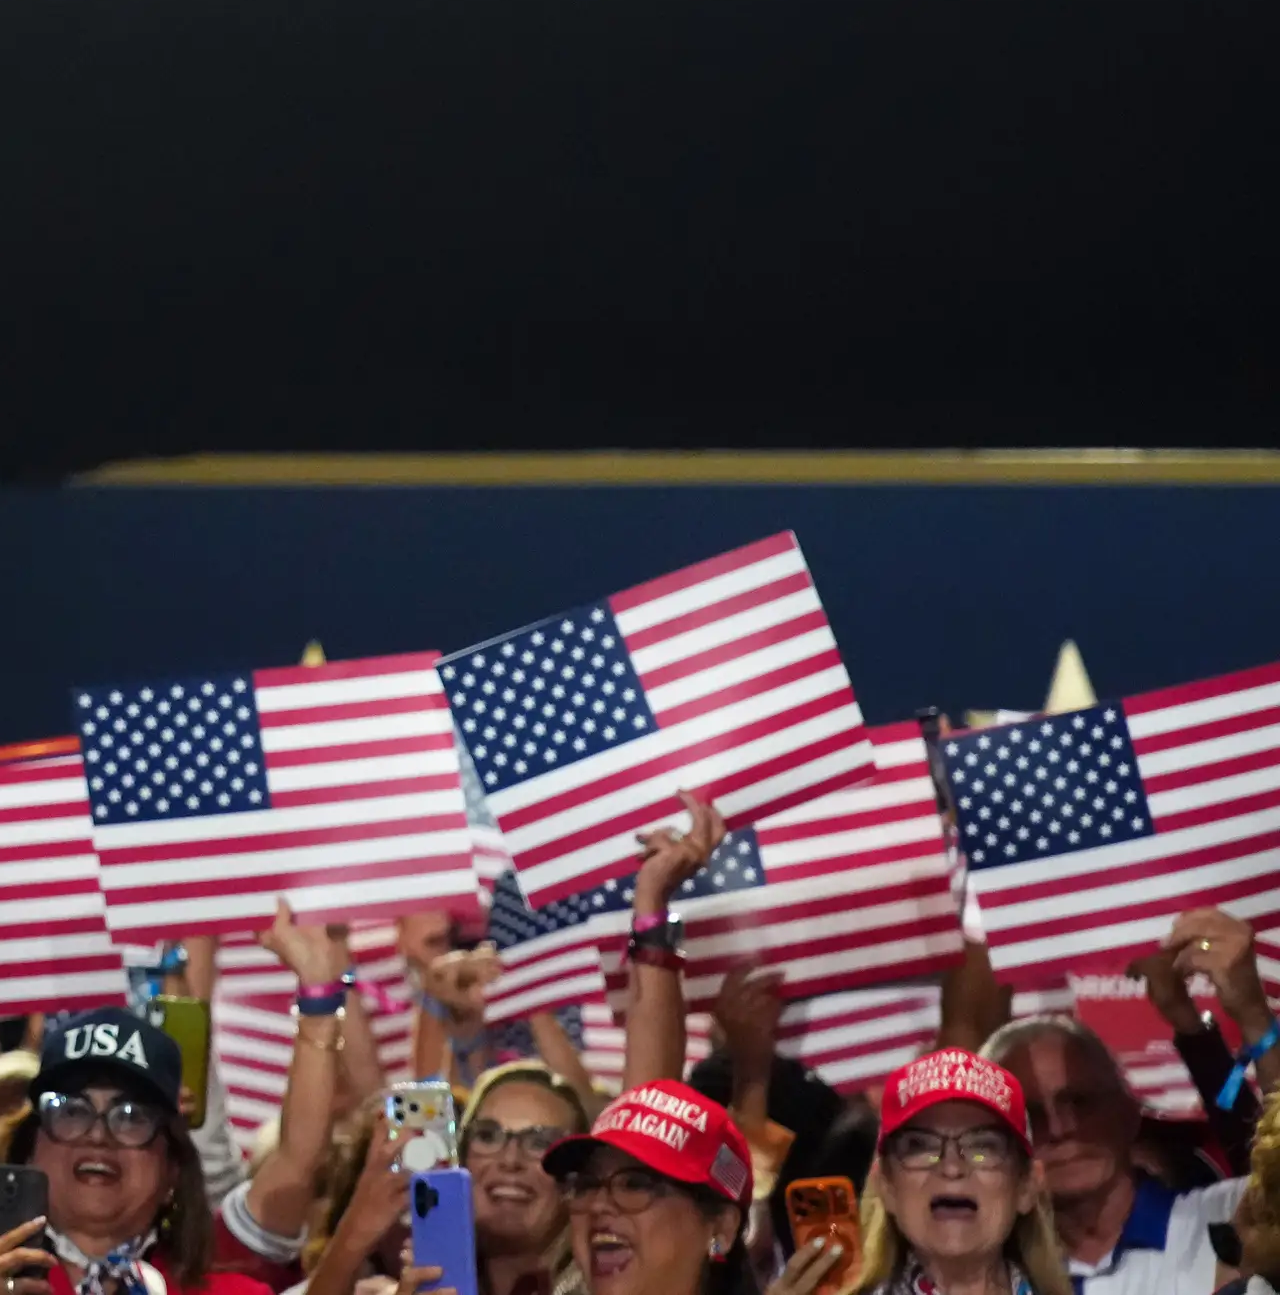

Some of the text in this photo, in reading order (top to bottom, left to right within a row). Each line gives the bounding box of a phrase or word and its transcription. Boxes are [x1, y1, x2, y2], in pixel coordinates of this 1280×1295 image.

[64, 1023, 149, 1069] USA
[906, 1051, 969, 1078] TRUMP
[629, 1087, 708, 1133] AMERICA
[627, 1113, 690, 1152] AGAIN
